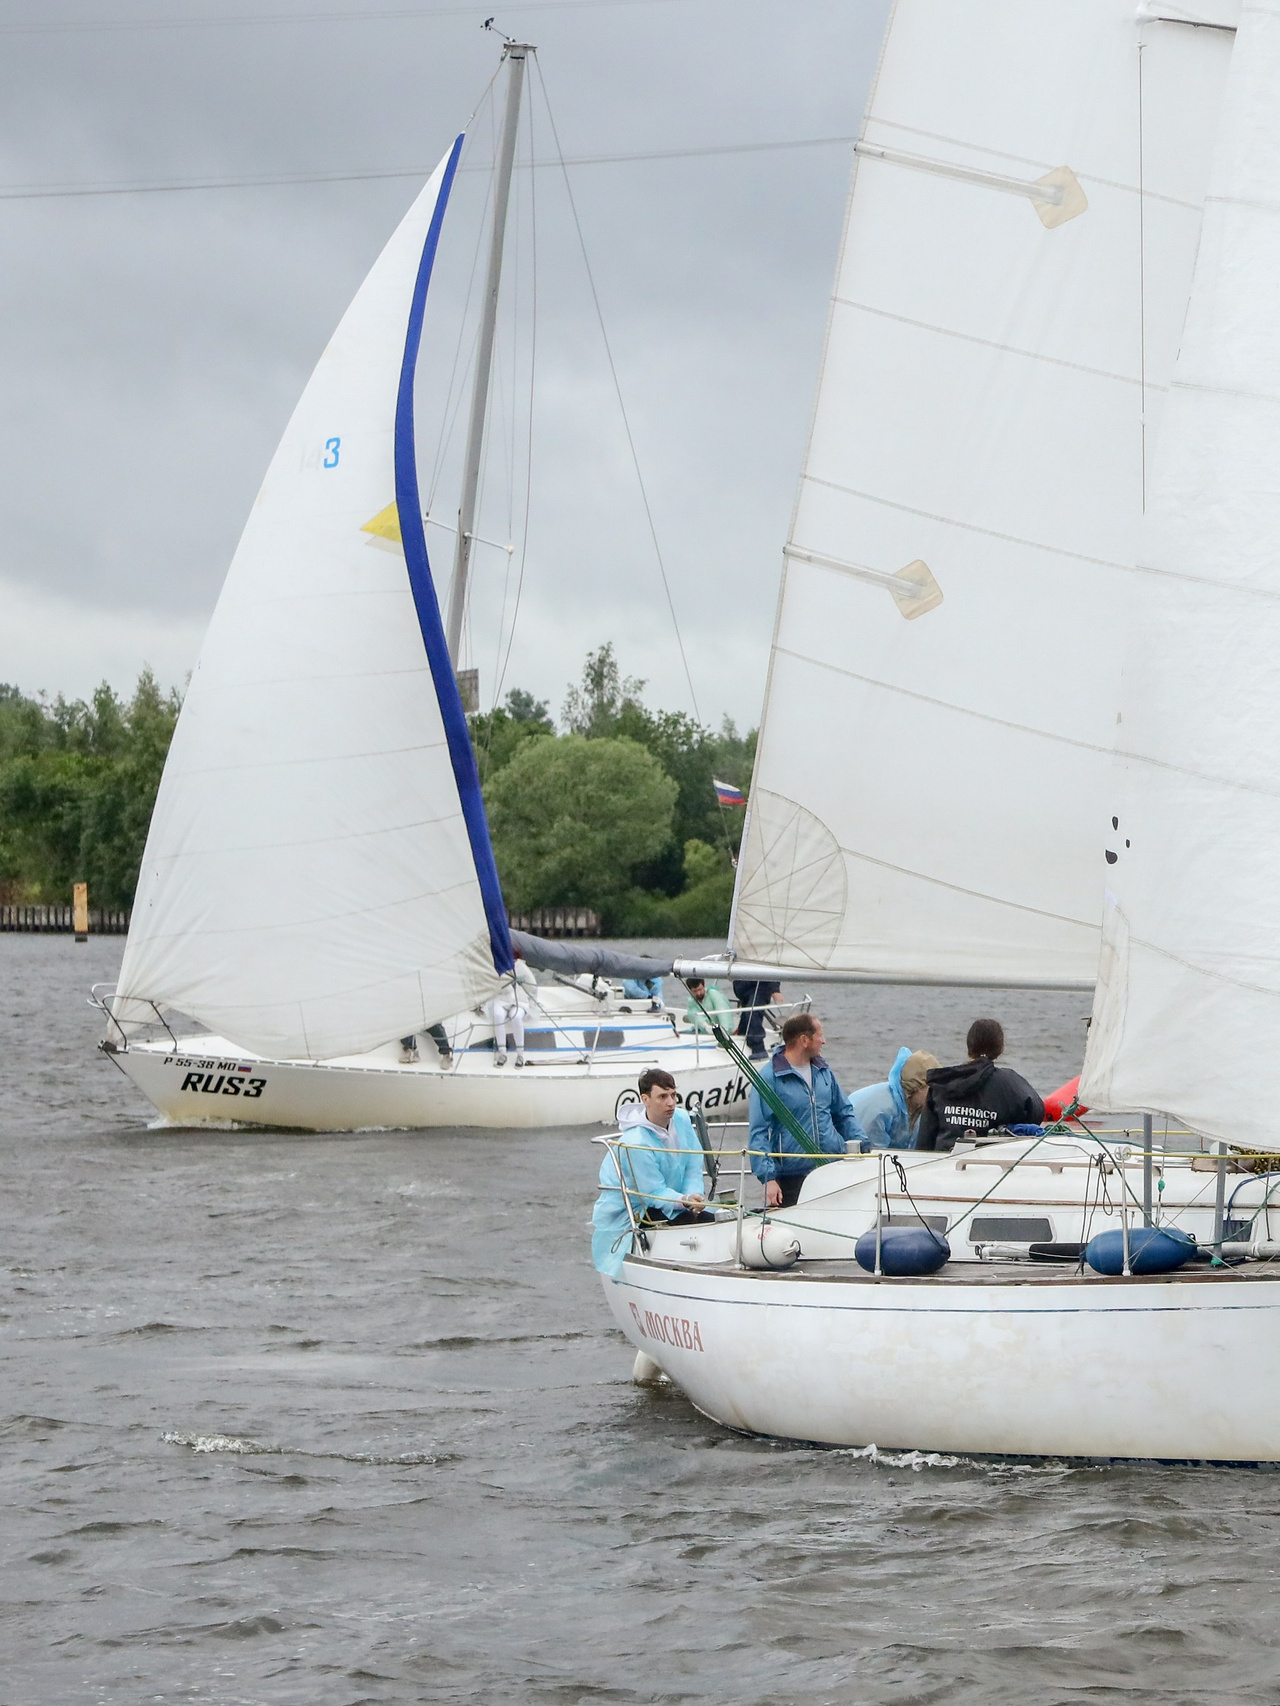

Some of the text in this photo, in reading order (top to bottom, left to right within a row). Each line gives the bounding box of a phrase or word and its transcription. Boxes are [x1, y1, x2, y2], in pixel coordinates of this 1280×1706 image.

[323, 437, 341, 469] 3
[175, 1058, 215, 1070] 55-38
[944, 1105, 998, 1121] МЕНЯЙСЯ
[950, 1115, 990, 1128] МЕНЯЙ
[644, 1309, 705, 1353] МОСКВА
